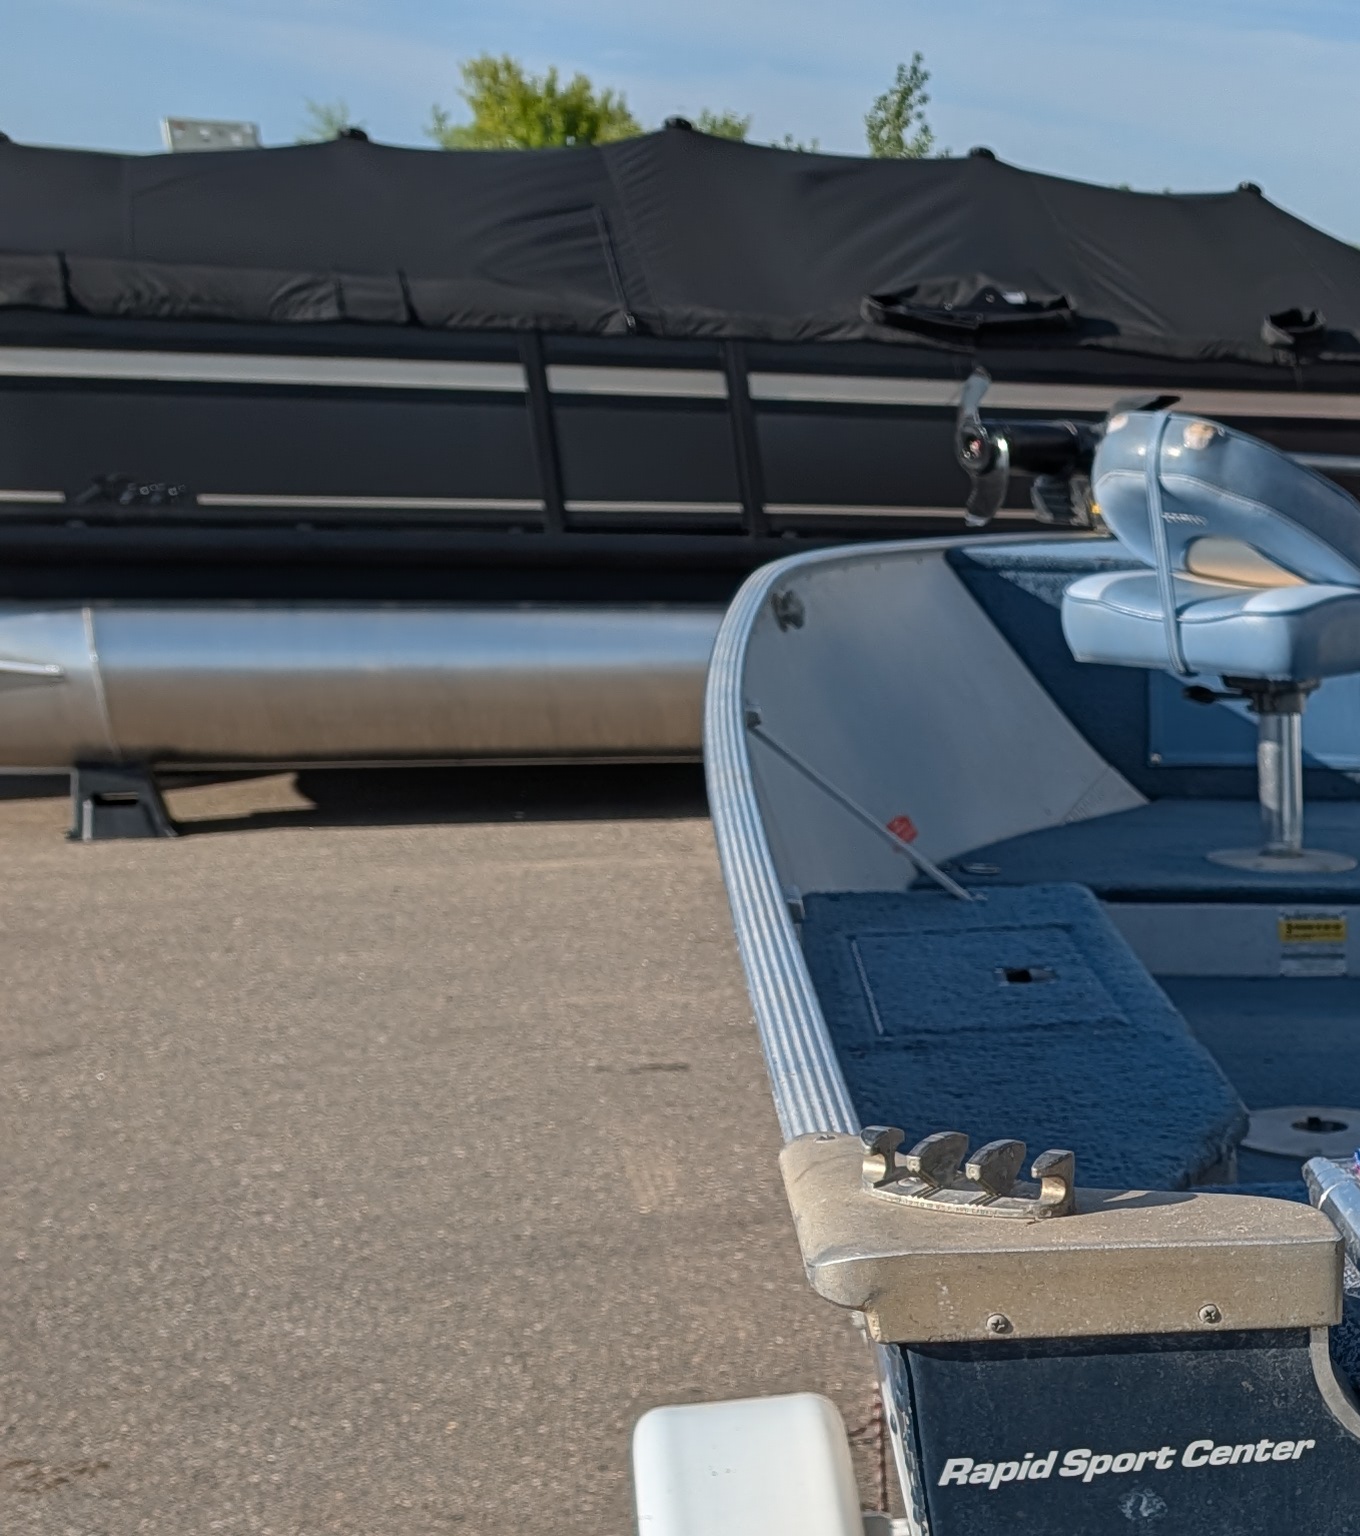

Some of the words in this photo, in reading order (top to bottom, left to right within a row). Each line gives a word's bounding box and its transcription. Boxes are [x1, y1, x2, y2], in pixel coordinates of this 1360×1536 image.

[938, 1450, 1058, 1490] Rapid
[1058, 1446, 1176, 1483] Sport
[1182, 1438, 1316, 1468] Center
